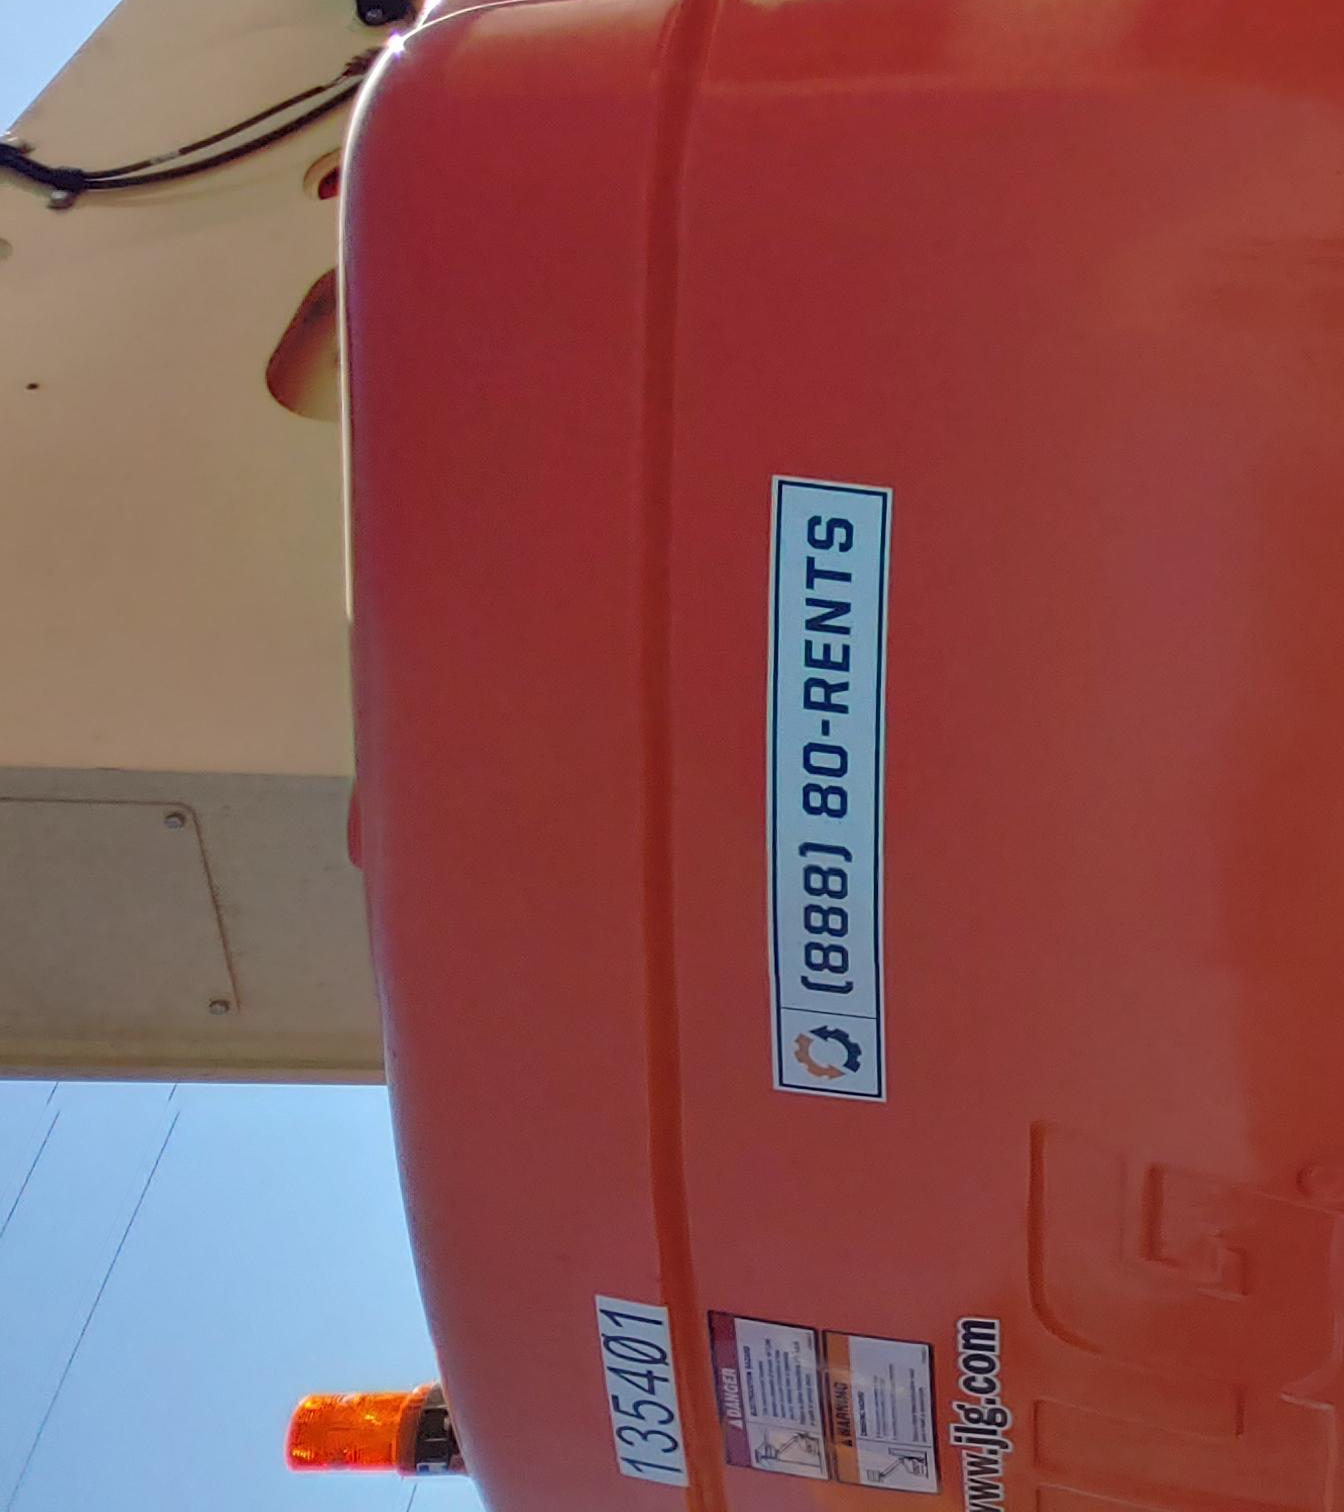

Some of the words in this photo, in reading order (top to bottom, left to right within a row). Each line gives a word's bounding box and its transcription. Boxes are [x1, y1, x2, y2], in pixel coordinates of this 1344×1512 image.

[803, 514, 854, 818] 80-RENTS
[798, 842, 853, 994] (888)
[599, 1308, 683, 1473] 135401
[721, 1367, 742, 1418] DANGER
[834, 1382, 851, 1437] WARNING
